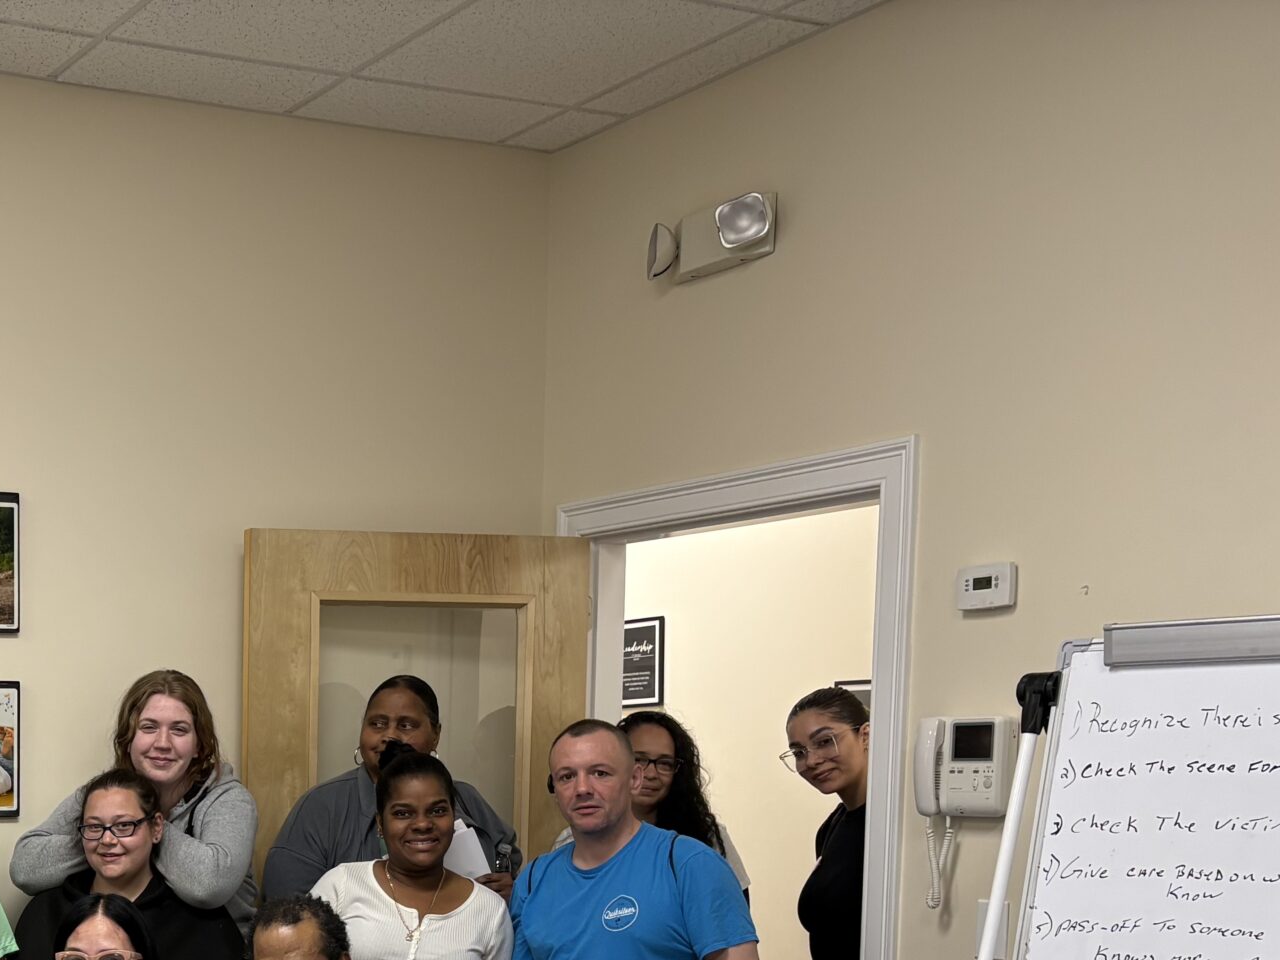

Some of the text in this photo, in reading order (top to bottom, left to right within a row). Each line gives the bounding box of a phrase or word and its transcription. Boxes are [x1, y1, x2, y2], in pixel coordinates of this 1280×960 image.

[623, 640, 654, 654] eadership
[1089, 702, 1191, 737] Recognize
[1081, 762, 1137, 778] Check
[1060, 856, 1109, 879] Give
